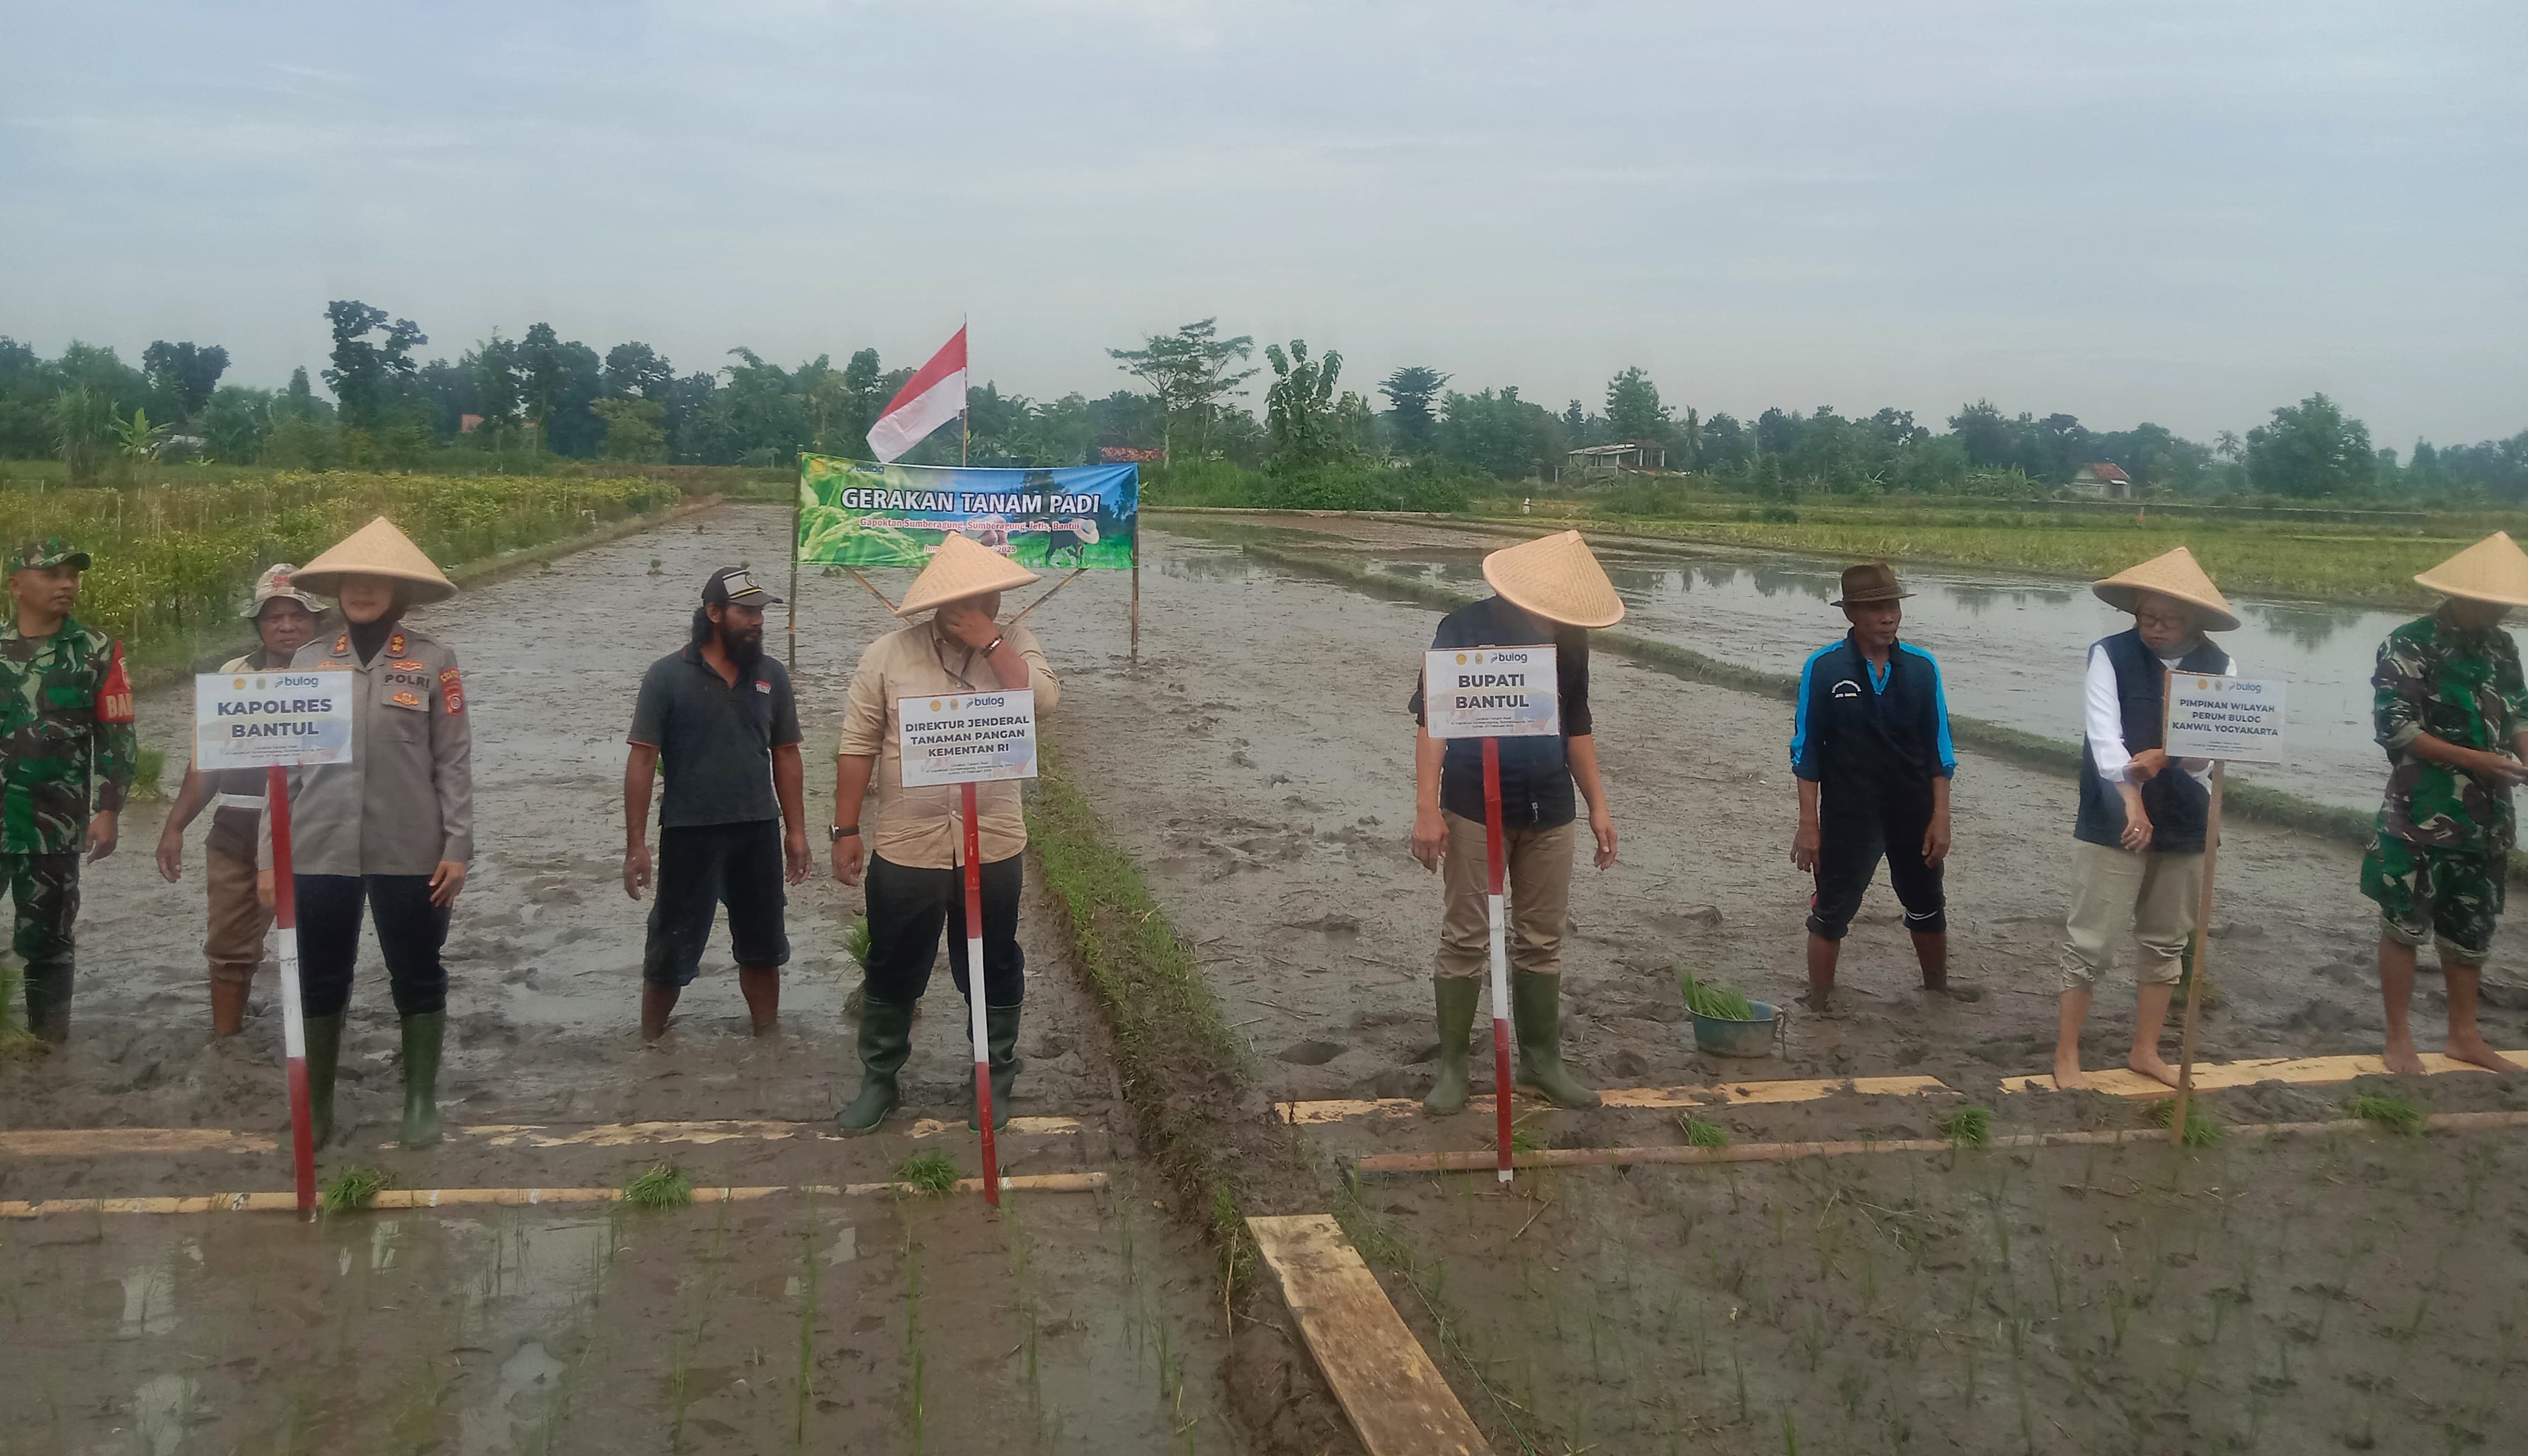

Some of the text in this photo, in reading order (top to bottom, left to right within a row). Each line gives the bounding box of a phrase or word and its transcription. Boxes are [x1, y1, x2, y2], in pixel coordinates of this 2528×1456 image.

[841, 488, 1101, 513] GERAKAN TANAM PADI
[860, 518, 902, 527] Gapoktan
[1499, 653, 1527, 663] bulog
[285, 676, 318, 687] bulog
[385, 675, 430, 688] POLRI
[1458, 674, 1525, 687] BUPATI
[2236, 682, 2261, 693] bulog
[218, 699, 332, 715] KAPOLRES
[975, 697, 1004, 707] bulog
[1455, 695, 1529, 709] BANTUL
[2180, 699, 2275, 712] PIMPINAN WILAYAH
[905, 716, 1029, 732] DIREKTUR JENDERAL
[2192, 712, 2261, 723] PERUM BULOG
[232, 722, 319, 738] BANTUL
[2172, 722, 2279, 736] KANWIL YOGYAKARTA
[911, 729, 1025, 745] TANAMAN PANGAN
[929, 745, 994, 757] KEMENTAN
